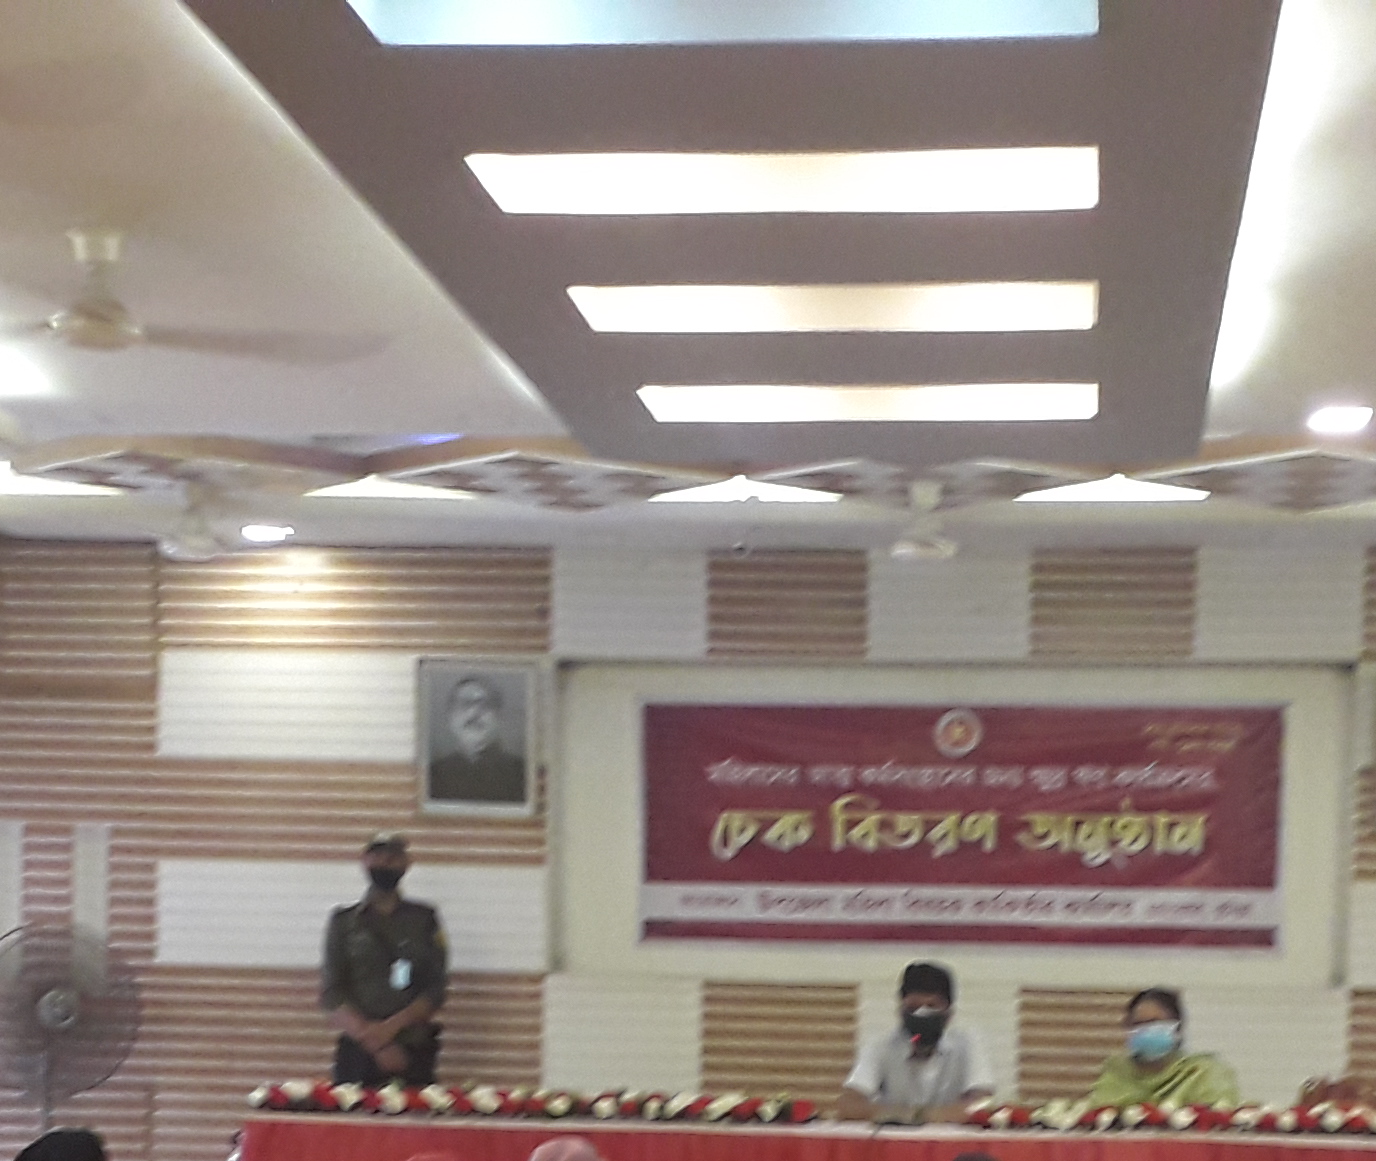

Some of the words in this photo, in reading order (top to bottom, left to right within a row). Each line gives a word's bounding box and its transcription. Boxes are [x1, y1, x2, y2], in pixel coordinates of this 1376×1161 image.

[710, 808, 815, 860] চেক
[829, 793, 999, 858] বিতরণ
[1017, 798, 1211, 868] অনুষ্ঠান
